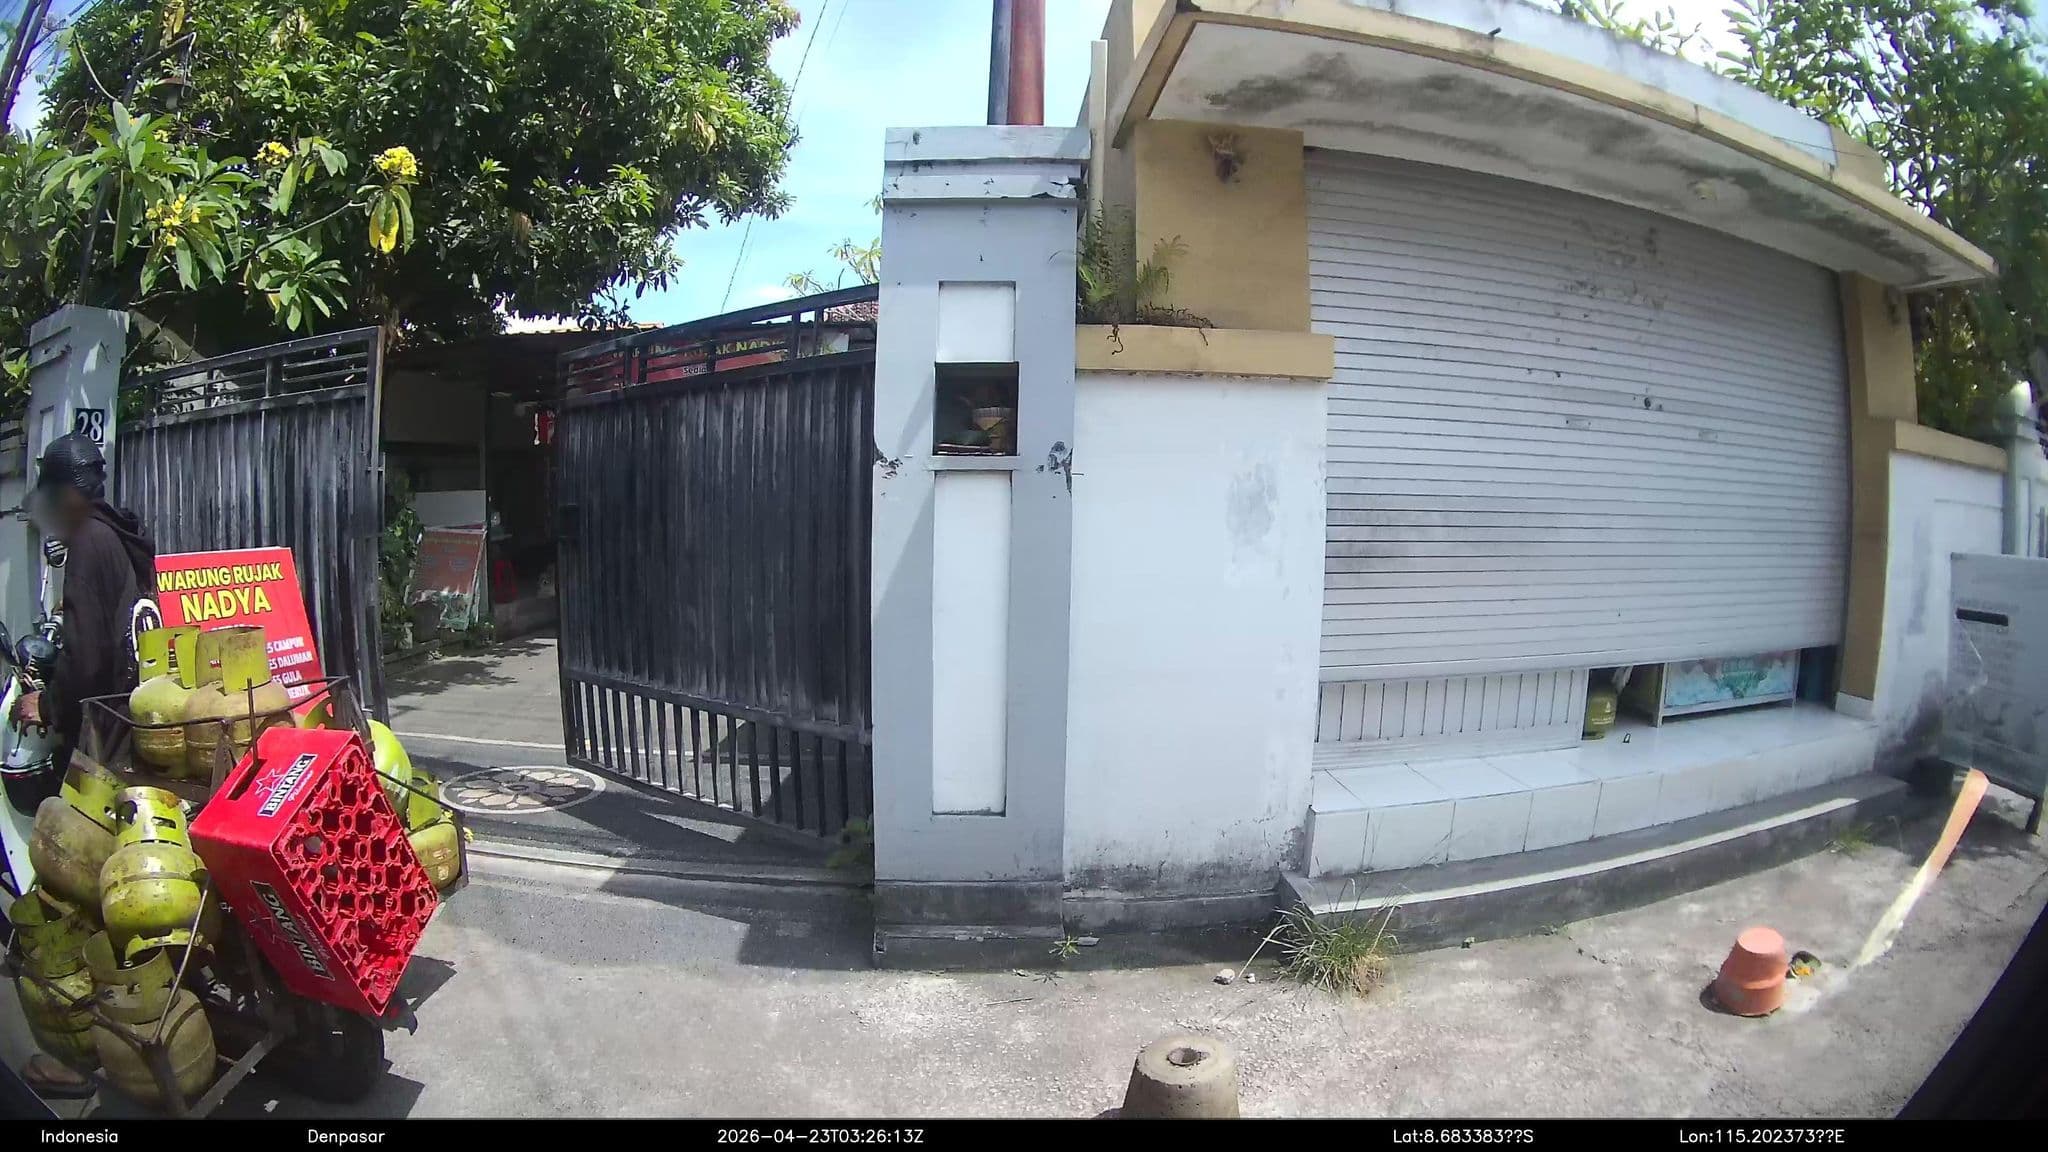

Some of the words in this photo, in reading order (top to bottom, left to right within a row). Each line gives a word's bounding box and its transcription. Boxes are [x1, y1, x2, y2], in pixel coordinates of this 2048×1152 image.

[78, 411, 103, 442] 28
[157, 566, 232, 592] WARUNG
[232, 562, 283, 584] RUJAK
[180, 585, 272, 624] NADYA
[281, 670, 302, 684] GULA
[262, 757, 313, 812] BINTANG
[262, 892, 328, 973] BINTANG
